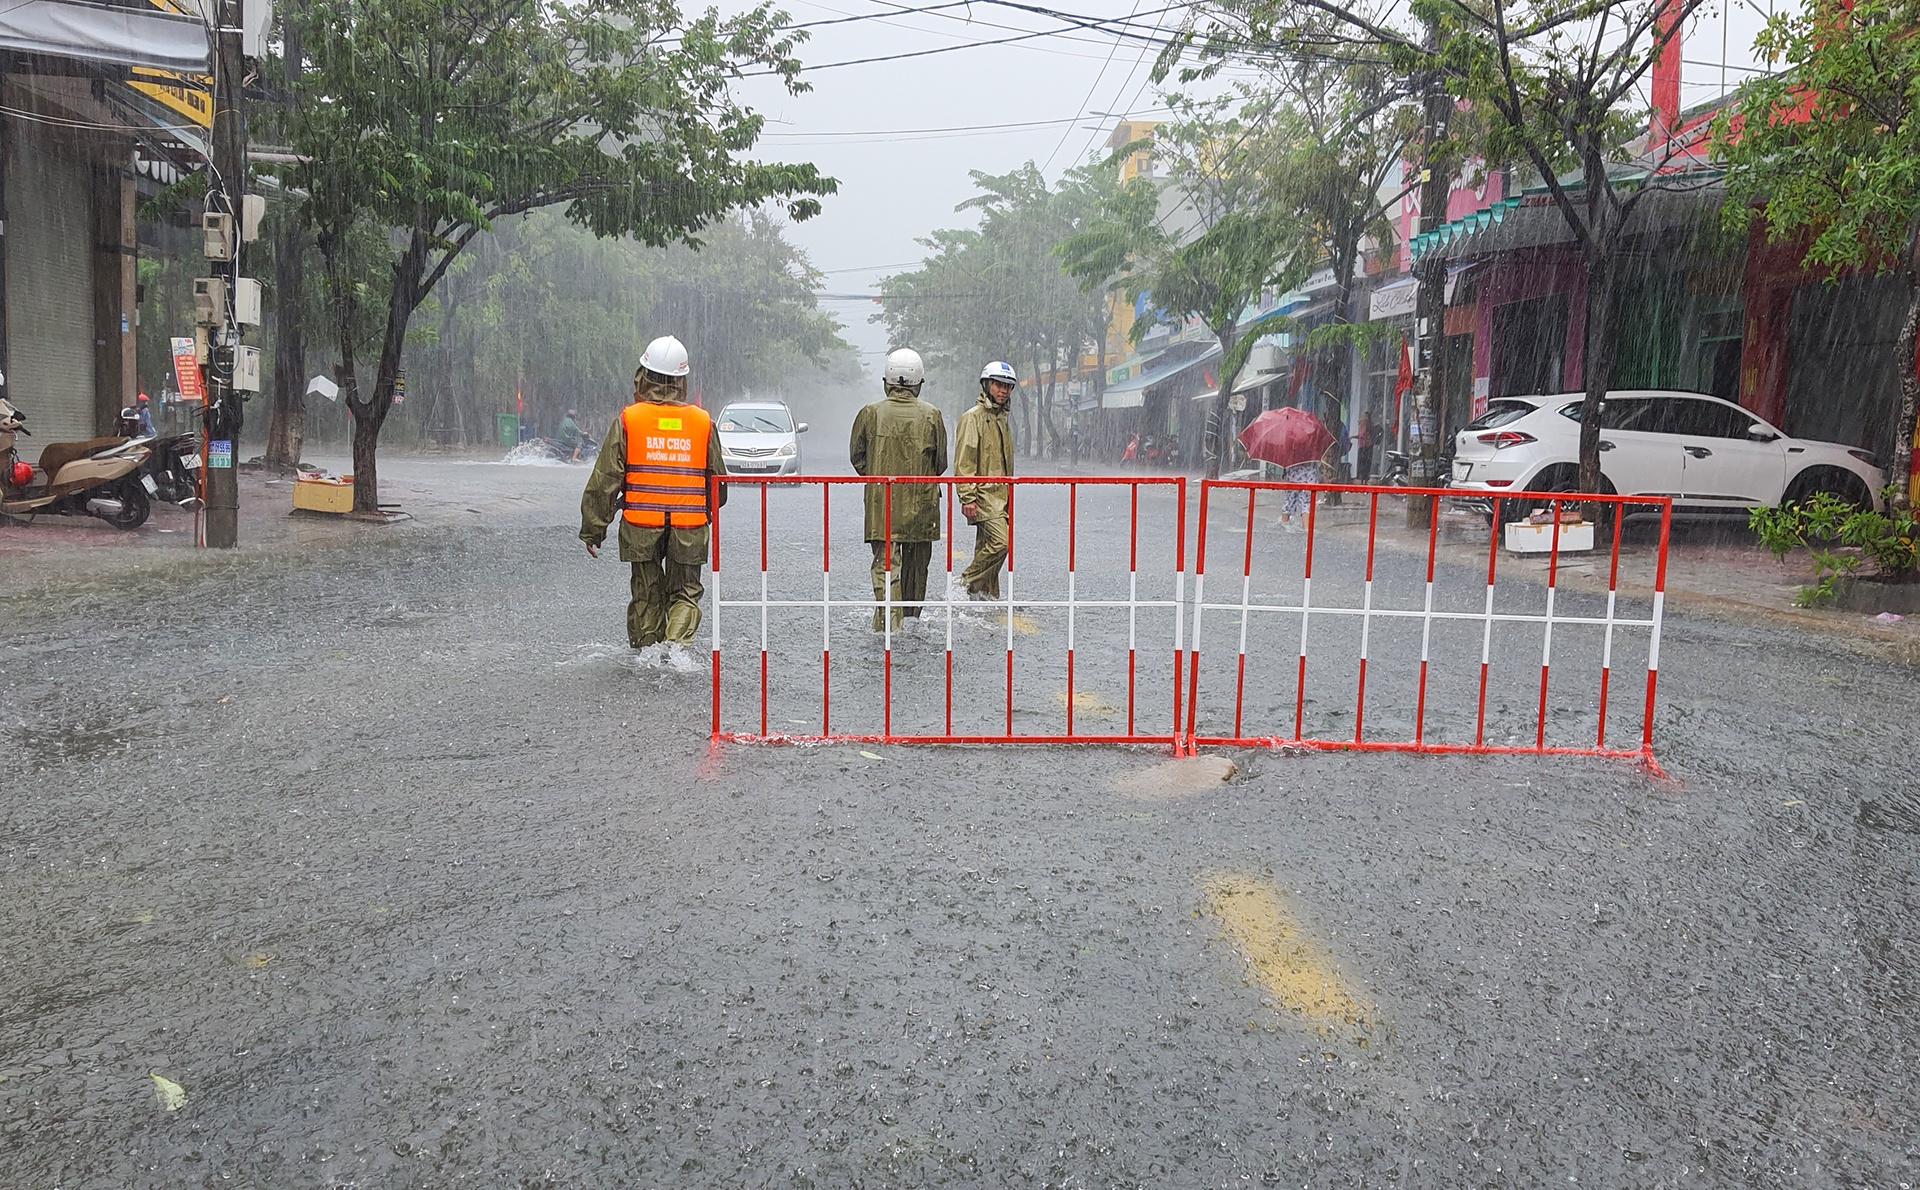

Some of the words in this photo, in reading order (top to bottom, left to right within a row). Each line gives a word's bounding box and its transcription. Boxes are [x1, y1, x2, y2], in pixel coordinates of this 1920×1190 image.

[646, 436, 665, 449] BAN
[667, 437, 691, 451] CHQS
[668, 453, 677, 461] AN
